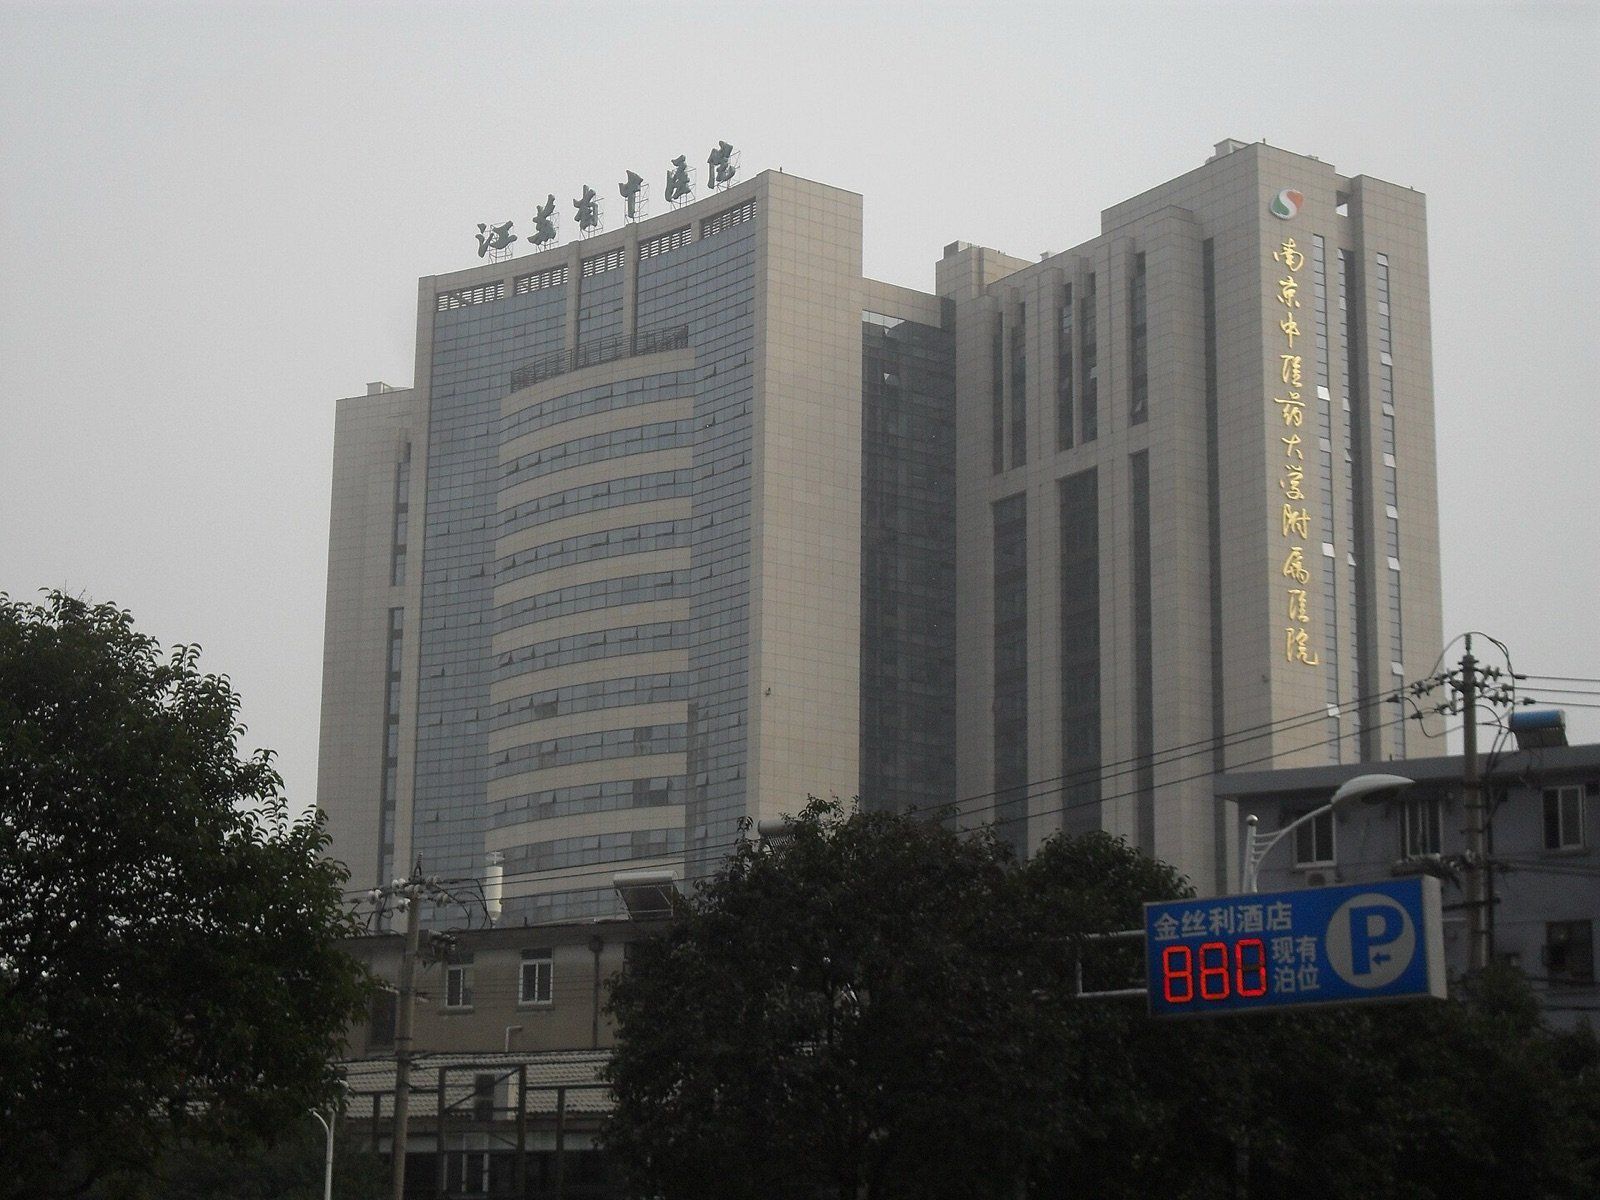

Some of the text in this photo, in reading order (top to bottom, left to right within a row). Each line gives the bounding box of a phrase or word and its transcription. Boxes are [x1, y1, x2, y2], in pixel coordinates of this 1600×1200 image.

[1154, 901, 1293, 941] 金丝利酒店
[1272, 935, 1319, 964] 现有
[1349, 904, 1404, 976] P
[1273, 964, 1320, 994] 泊位
